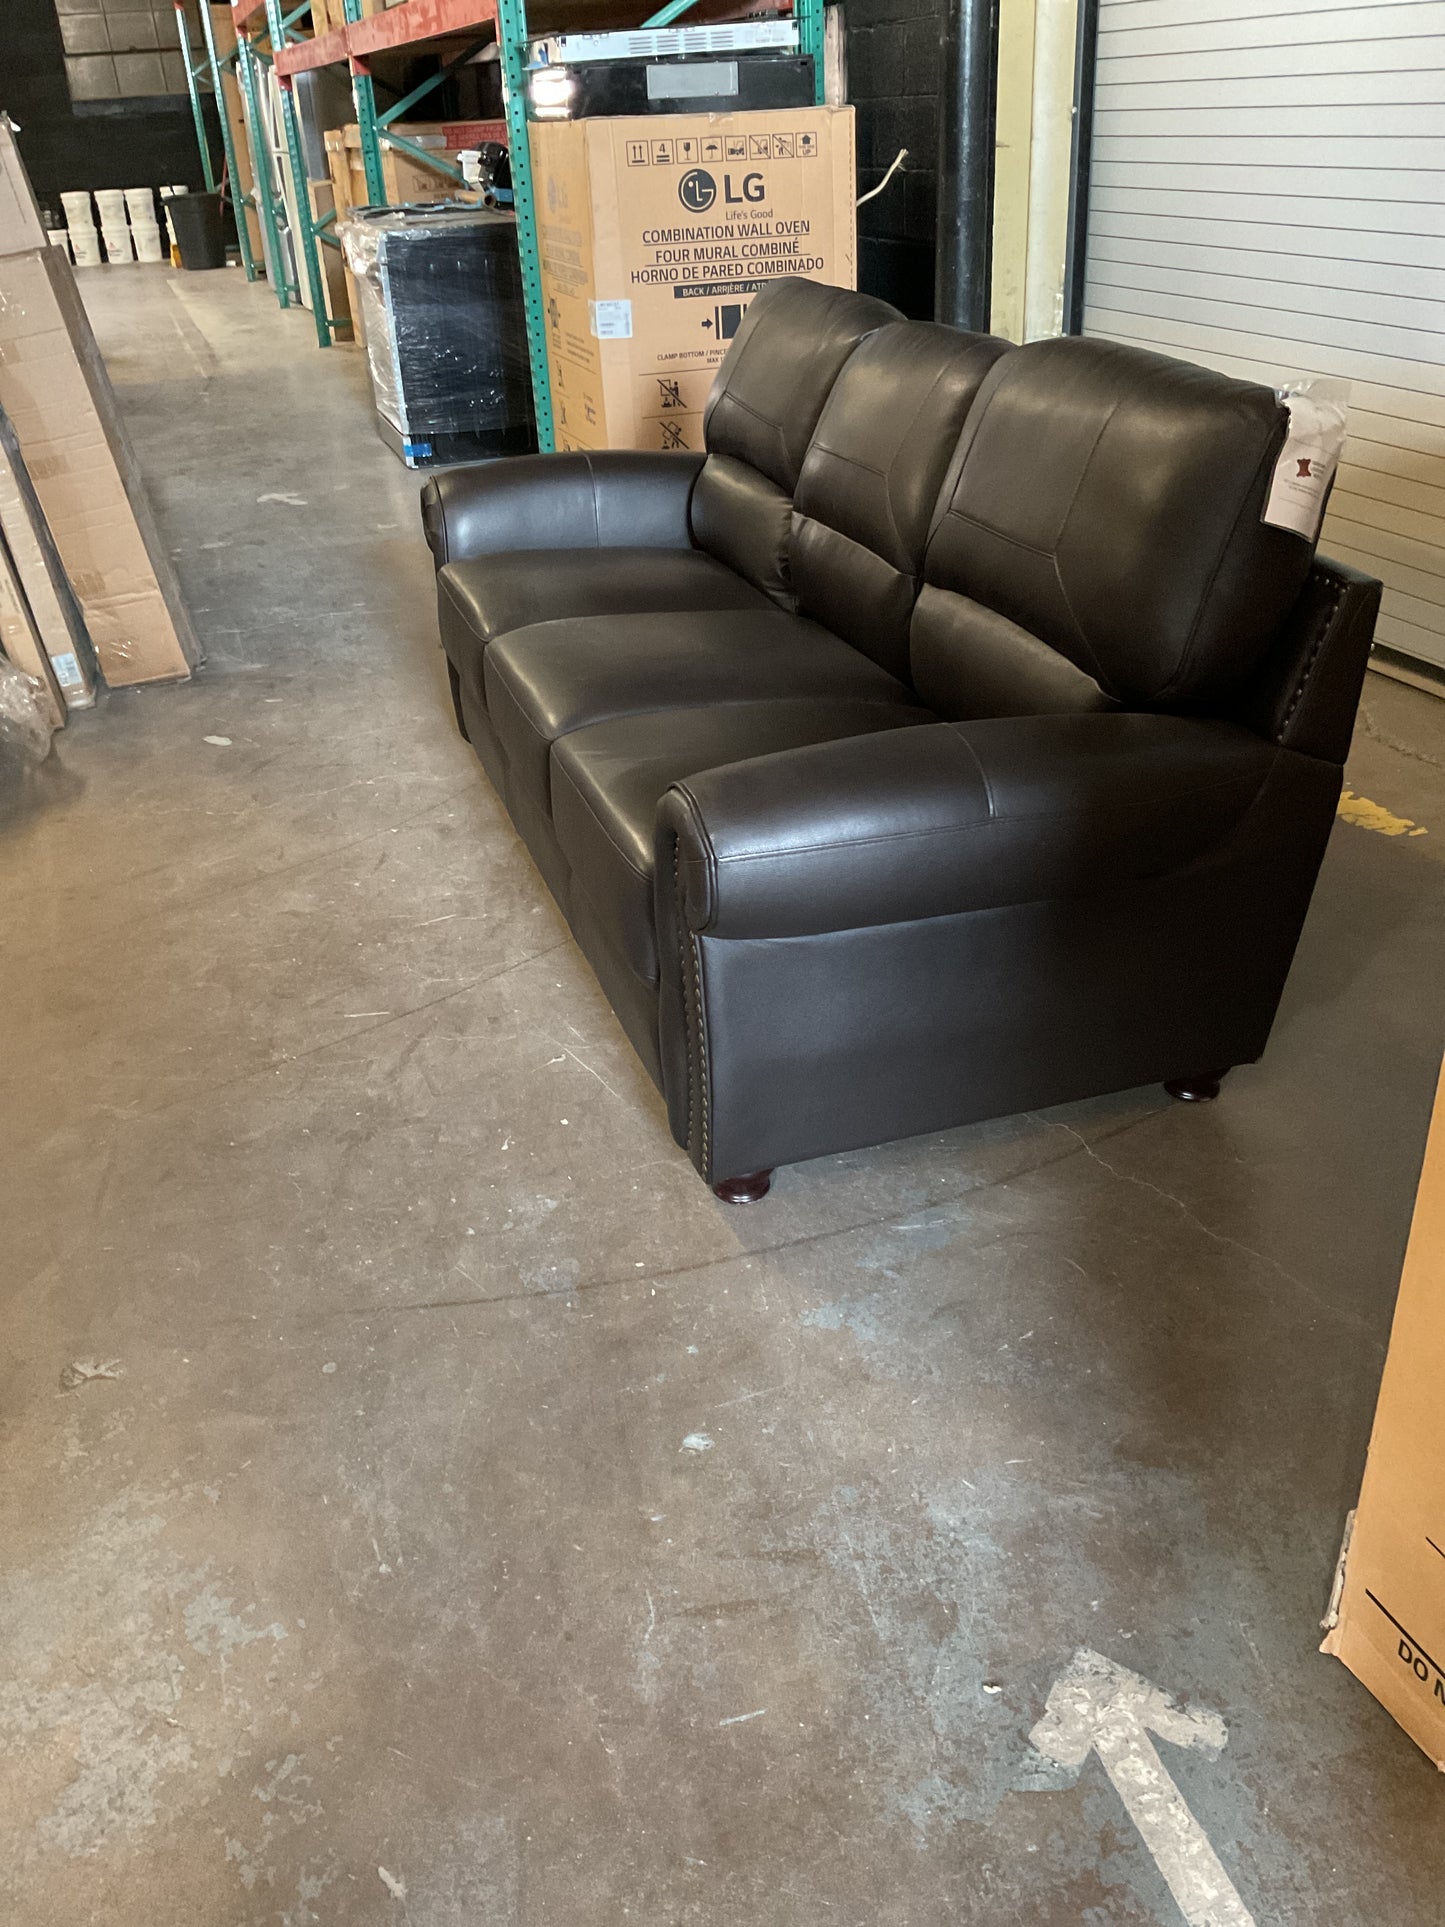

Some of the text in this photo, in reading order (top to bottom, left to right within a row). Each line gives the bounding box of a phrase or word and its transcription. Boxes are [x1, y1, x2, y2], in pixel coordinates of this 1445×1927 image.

[724, 173, 765, 203] LG
[726, 208, 774, 221] Life's Good
[642, 220, 810, 244] COMBINATION WALL OVEN
[655, 237, 799, 263] FOUR MURAL COMBINÉ
[631, 257, 824, 283] HORNO DE PARED COMBINADO
[682, 287, 704, 297] BACK
[656, 352, 678, 361] CLAMP
[679, 350, 704, 359] BOTTOM
[1398, 1638, 1429, 1682] DO
